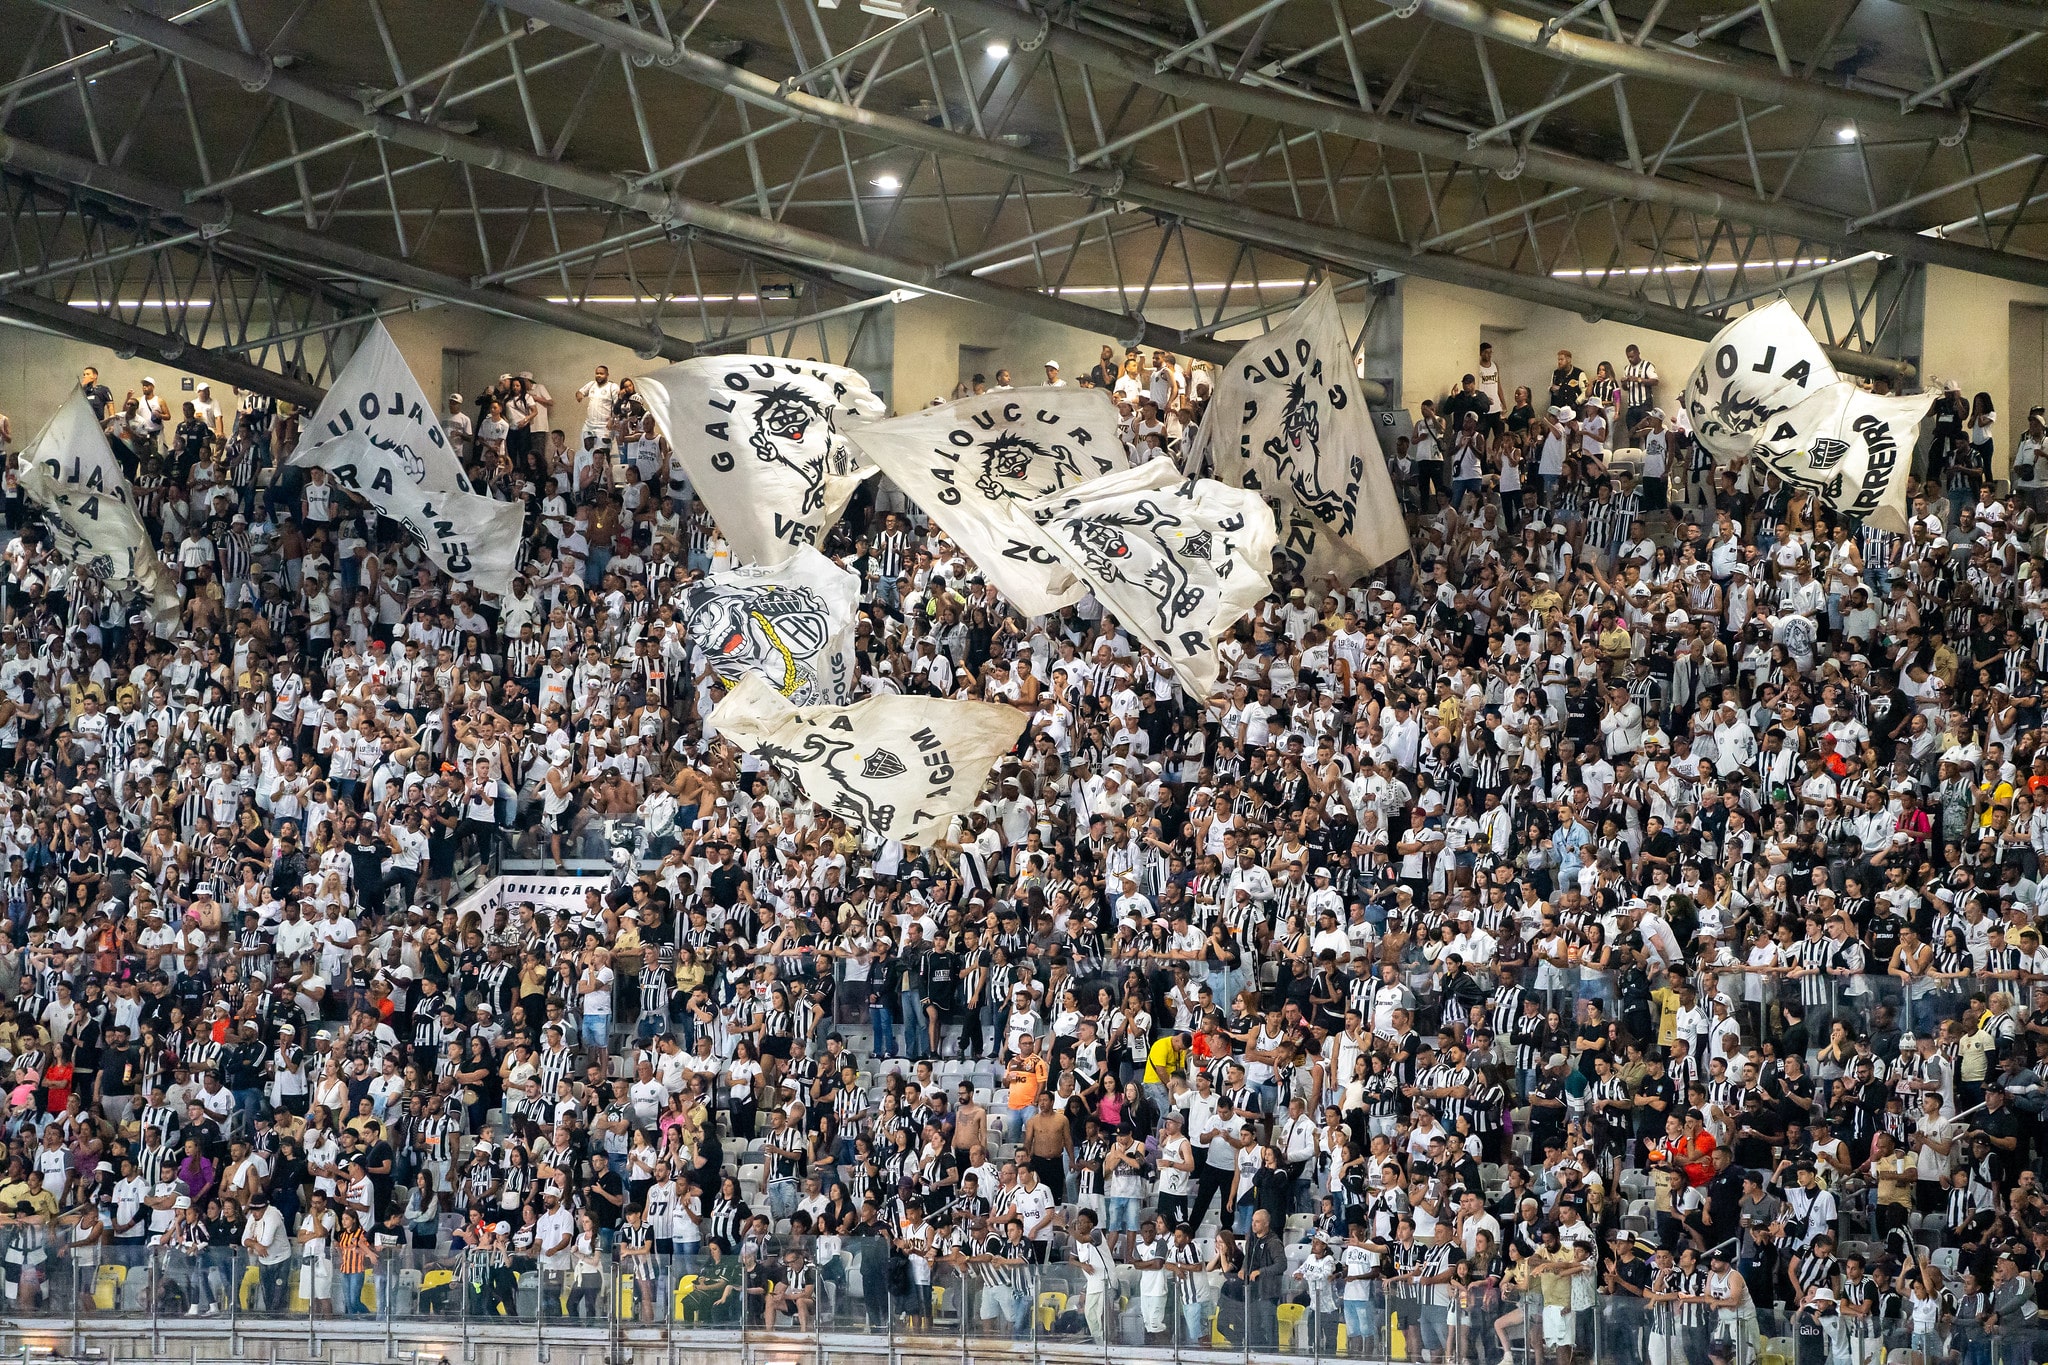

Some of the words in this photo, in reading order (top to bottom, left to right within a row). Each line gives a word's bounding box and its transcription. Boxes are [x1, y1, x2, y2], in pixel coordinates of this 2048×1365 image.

[1482, 375, 1497, 383] NORTE
[930, 402, 1114, 507] GALOUCURA
[649, 1202, 668, 1216] 07
[1025, 1210, 1041, 1219] bmg
[1799, 1325, 1820, 1336] Galo
